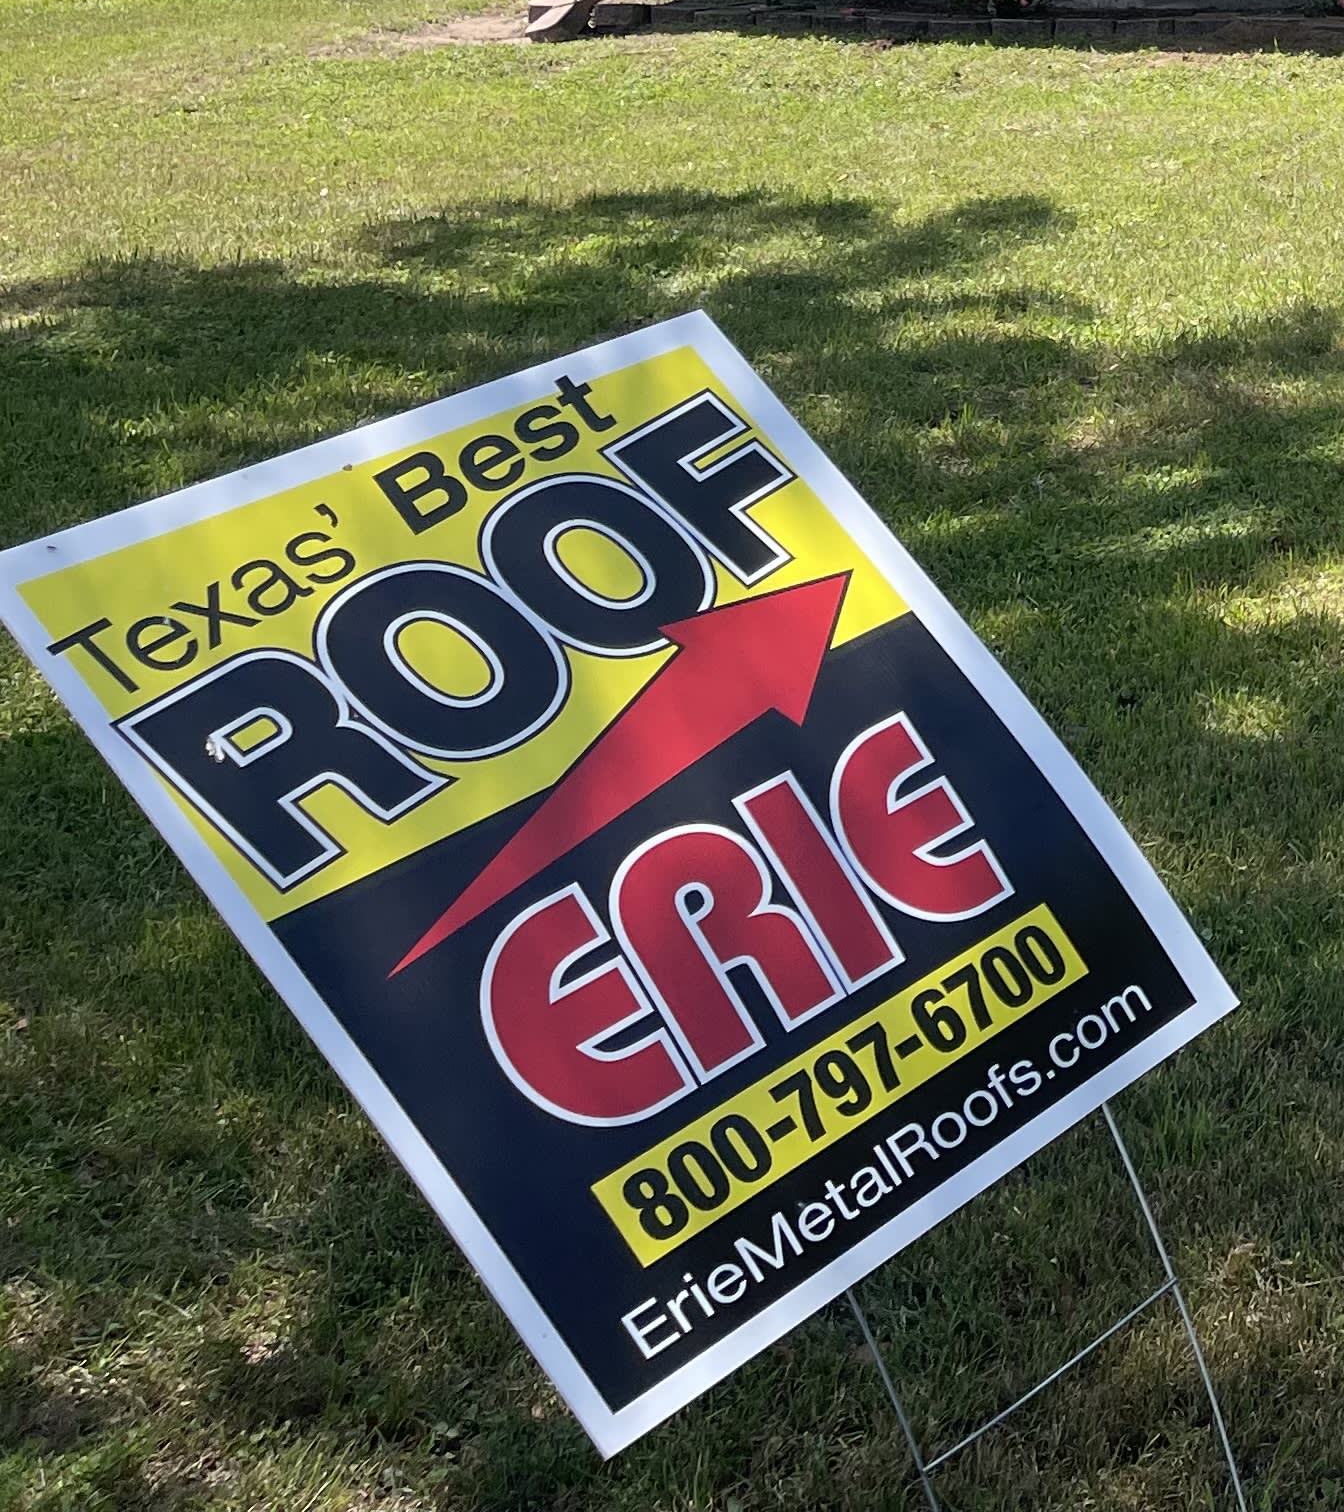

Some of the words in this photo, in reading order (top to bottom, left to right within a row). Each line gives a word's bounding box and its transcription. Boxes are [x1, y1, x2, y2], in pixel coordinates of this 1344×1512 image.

[46, 504, 356, 694] Texas'
[371, 374, 617, 536] Best
[110, 388, 797, 893] ROOF
[480, 710, 1016, 1128] ERIE
[622, 924, 1067, 1241] 800-797-6700
[621, 984, 1152, 1360] ErieMetalRoofs.com
